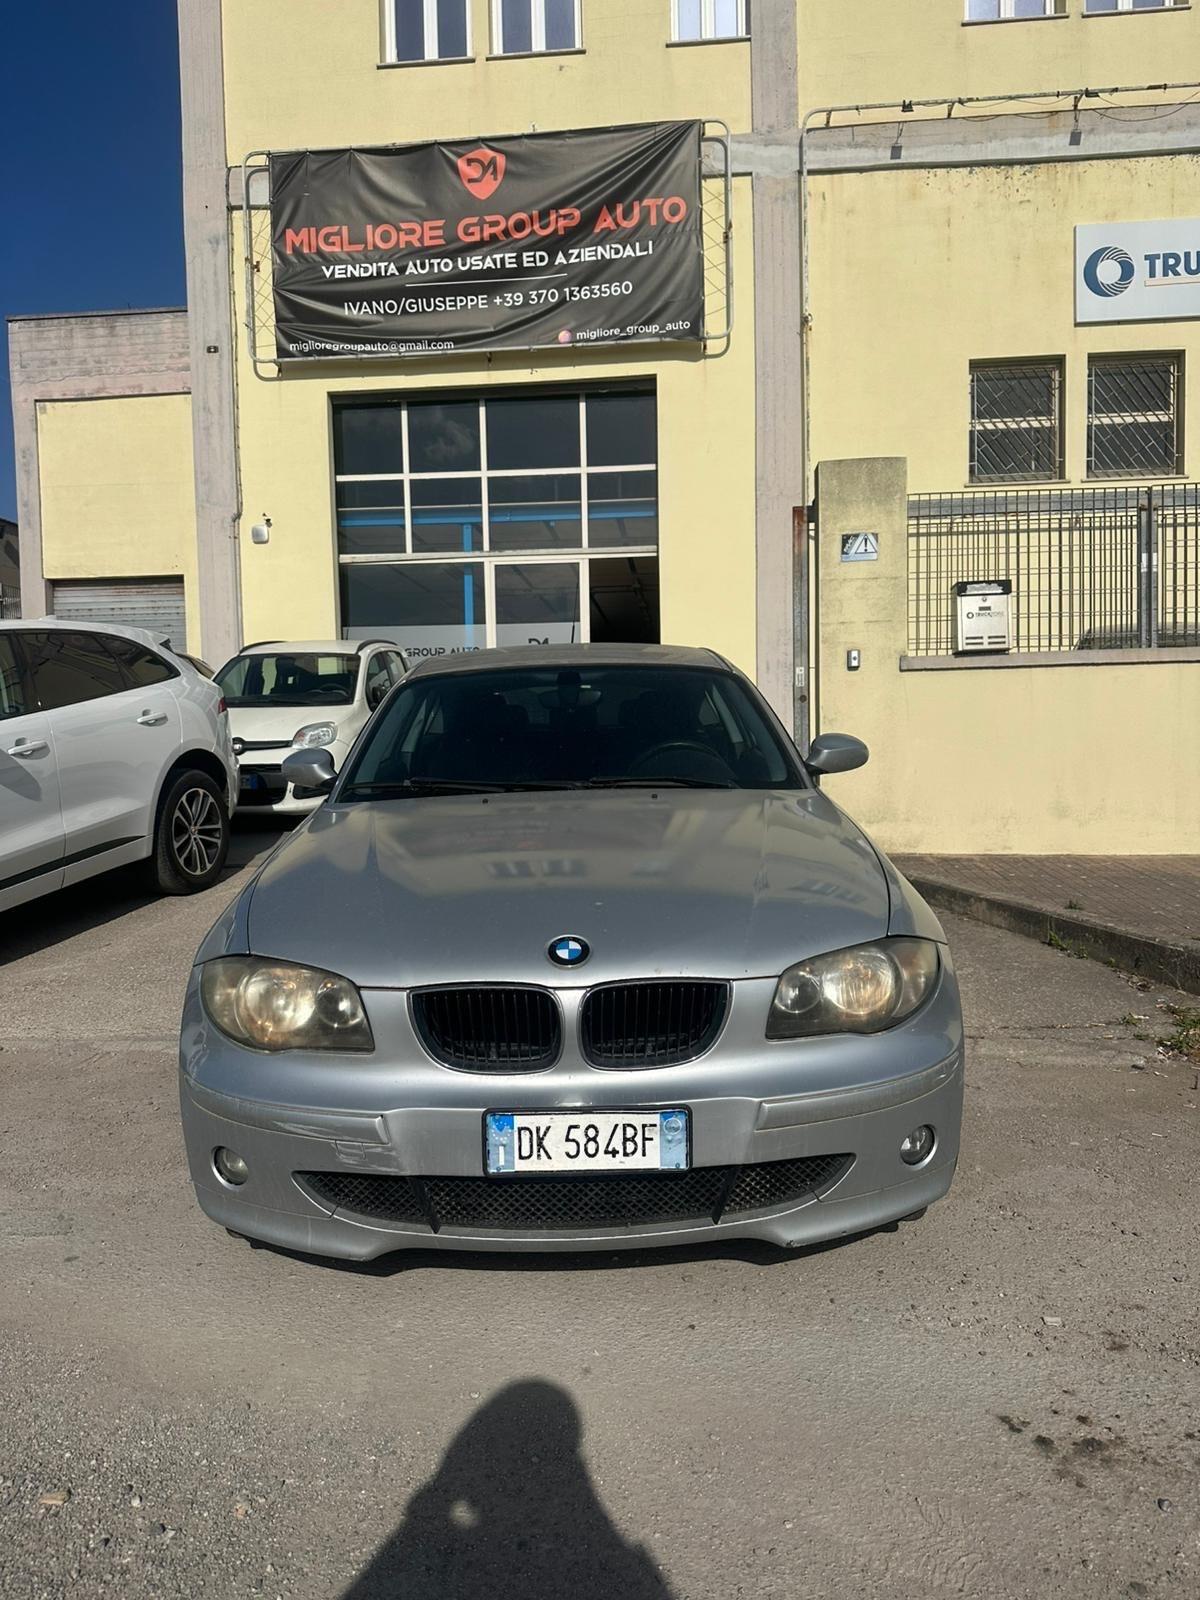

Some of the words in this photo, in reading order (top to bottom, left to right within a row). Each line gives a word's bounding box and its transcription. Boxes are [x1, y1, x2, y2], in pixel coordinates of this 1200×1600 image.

[285, 219, 446, 254] MIGLIORE
[457, 207, 581, 242] GROUP
[594, 196, 687, 233] AUTO
[322, 261, 399, 279] VENDITA
[405, 257, 453, 275] AUTO
[457, 252, 518, 271] USATE
[522, 251, 549, 267] ED
[554, 240, 653, 265] AZIENDALI
[1143, 250, 1200, 278] TRU
[344, 294, 488, 316] IVANO/GIUSEPPE
[493, 292, 523, 307] +39
[528, 288, 559, 304] 370
[563, 280, 633, 301] 1363560
[576, 319, 691, 340] migliore_group_auto
[289, 339, 454, 354] miglioregroupauto@gmail.com
[405, 647, 445, 657] GROUP
[517, 1125, 552, 1160] DK
[564, 1123, 657, 1159] 584BF
